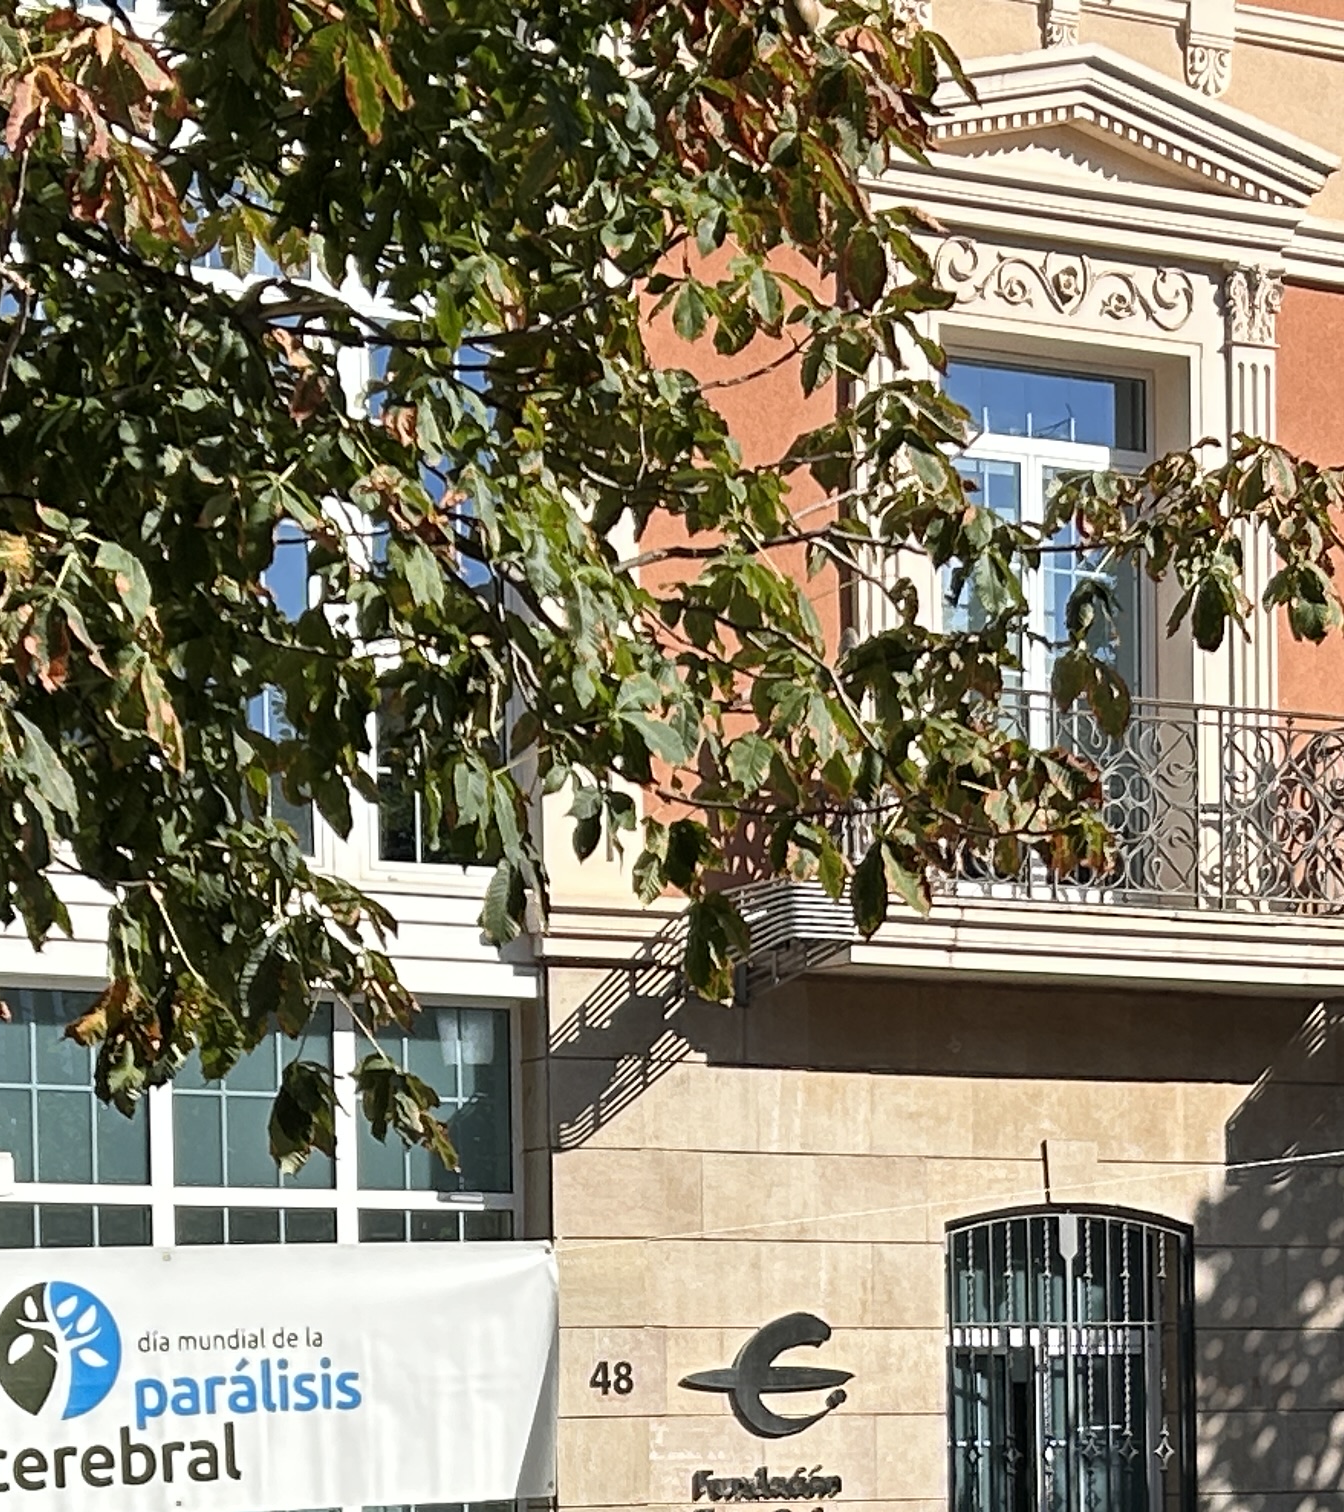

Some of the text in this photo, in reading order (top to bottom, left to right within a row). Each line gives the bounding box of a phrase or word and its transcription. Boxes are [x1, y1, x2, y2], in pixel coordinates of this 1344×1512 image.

[178, 1328, 266, 1351] mundial
[273, 1327, 298, 1349] de
[306, 1326, 324, 1348] la
[135, 1356, 363, 1430] parálisis
[589, 1361, 634, 1396] 48
